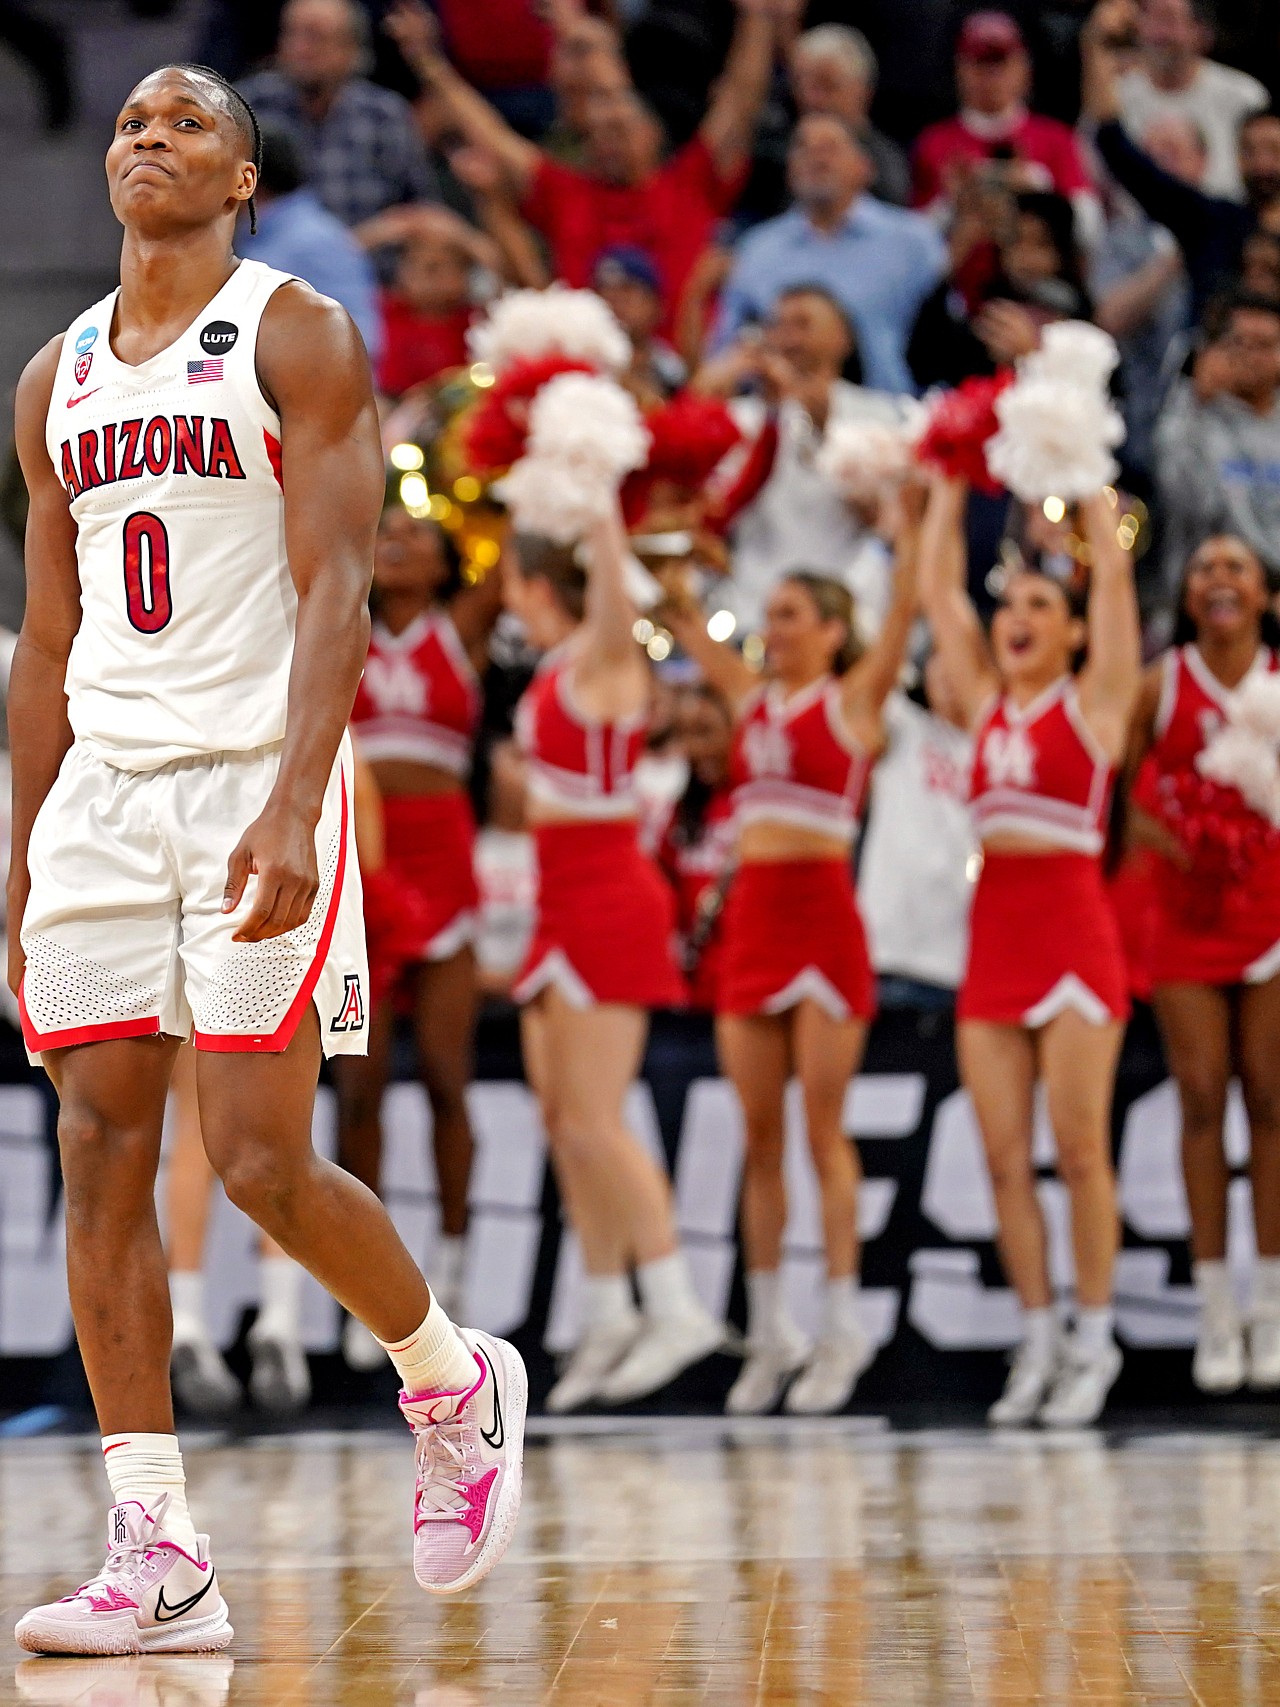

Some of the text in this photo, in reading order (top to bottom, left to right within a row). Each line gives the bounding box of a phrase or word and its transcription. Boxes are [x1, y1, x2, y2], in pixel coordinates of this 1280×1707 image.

[203, 332, 236, 343] LUTE
[61, 415, 246, 500] ARIZONA
[123, 511, 172, 634] 0
[330, 974, 364, 1032] A
